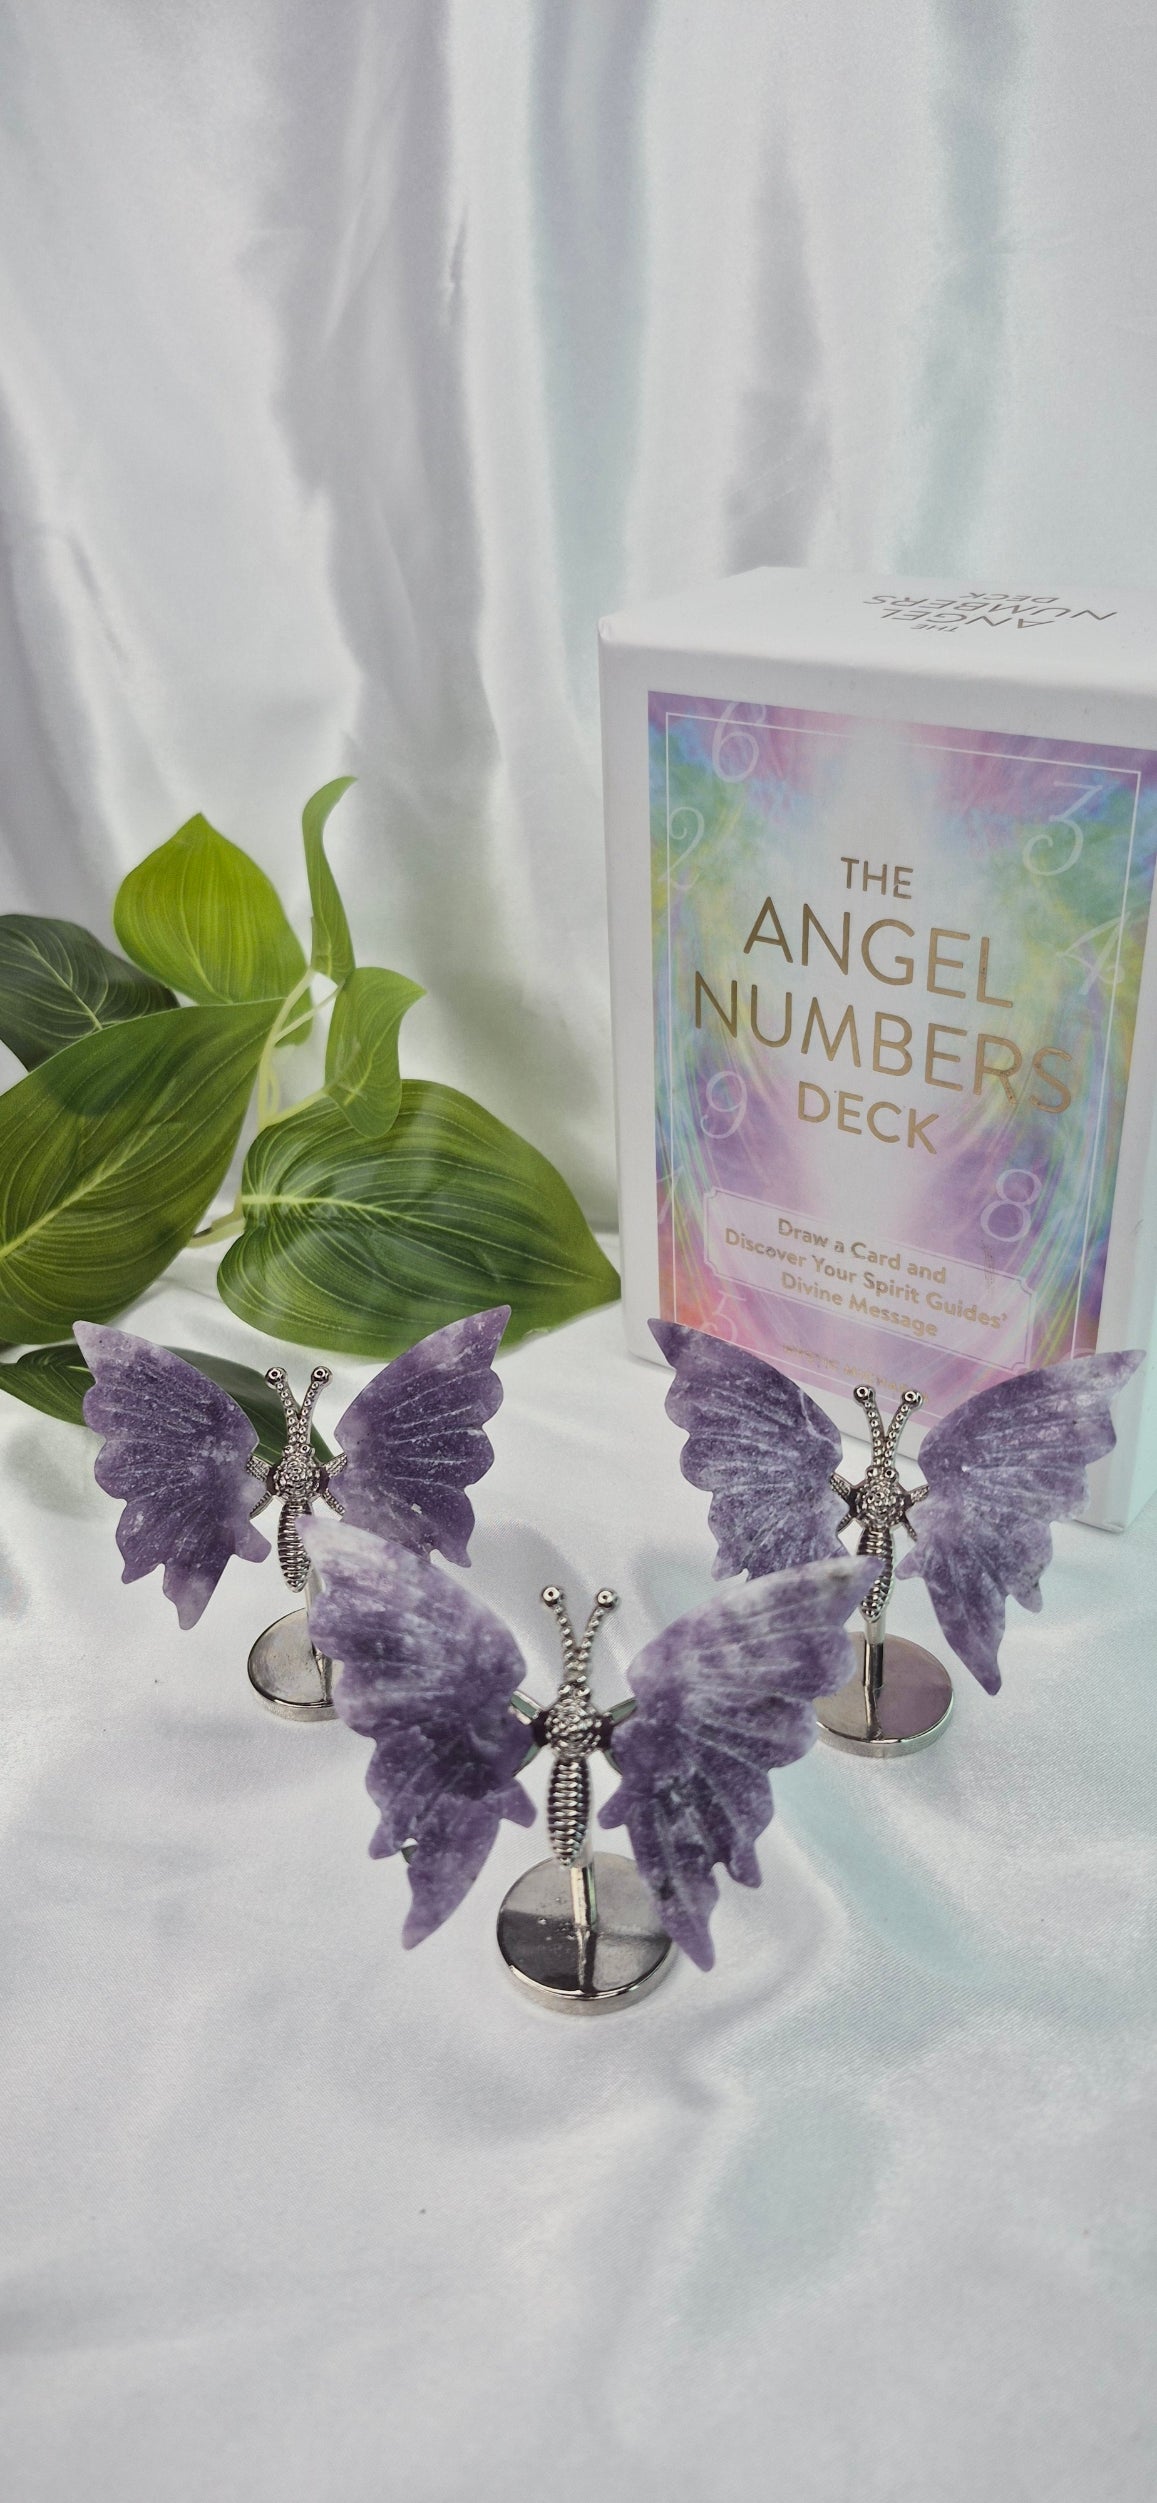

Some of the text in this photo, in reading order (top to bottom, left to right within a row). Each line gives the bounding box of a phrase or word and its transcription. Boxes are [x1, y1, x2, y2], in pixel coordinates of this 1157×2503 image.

[863, 595, 1118, 621] NUMBERS
[881, 608, 1055, 629] ANGEL
[910, 624, 960, 632] THE
[959, 592, 1061, 604] DECK
[1021, 779, 1103, 876] 3
[840, 856, 914, 900] THE
[743, 896, 1014, 1008] ANGEL
[695, 970, 1073, 1114] NUMBERS
[798, 1080, 940, 1155] DECK
[979, 1168, 1042, 1243] 8
[725, 1228, 807, 1267] Discover
[811, 1255, 857, 1284] Your
[863, 1271, 920, 1306] Spirit
[778, 1218, 947, 1285] Draw a Card and
[781, 1271, 938, 1337] Divine Message
